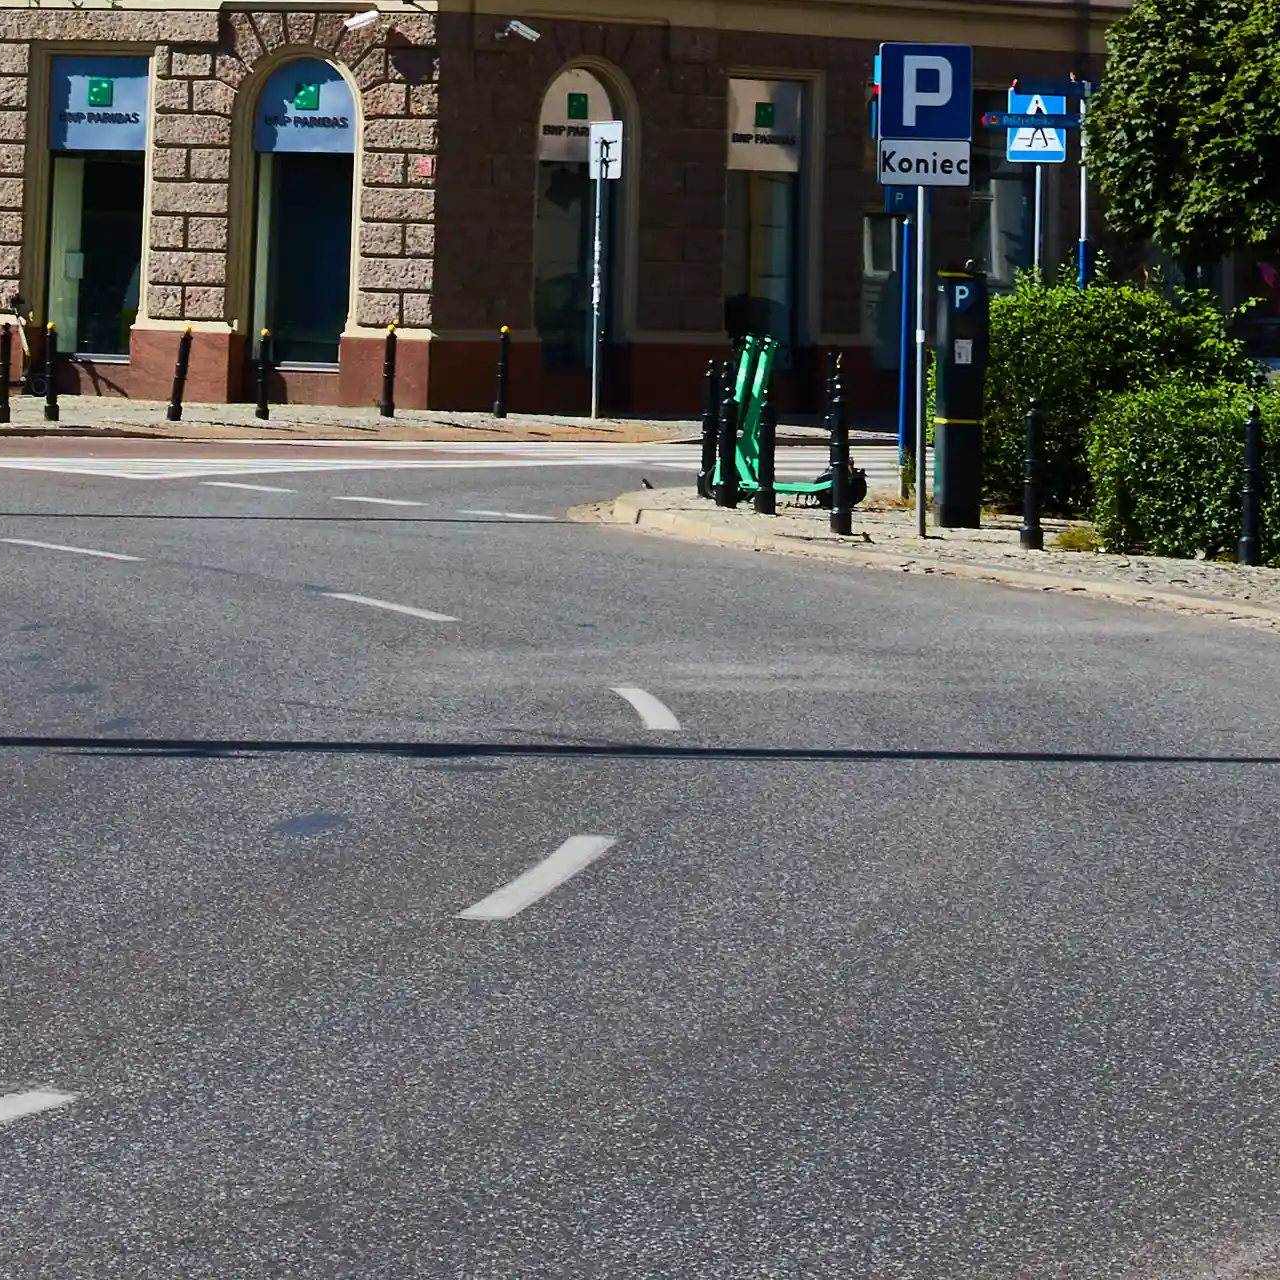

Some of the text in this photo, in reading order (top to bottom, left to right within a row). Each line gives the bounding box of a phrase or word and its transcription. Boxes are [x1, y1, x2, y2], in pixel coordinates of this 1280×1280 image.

[903, 55, 952, 126] P
[87, 111, 140, 125] PARIBAS
[293, 115, 349, 129] PARIBAS
[882, 150, 969, 175] Koniec
[955, 285, 969, 308] P
